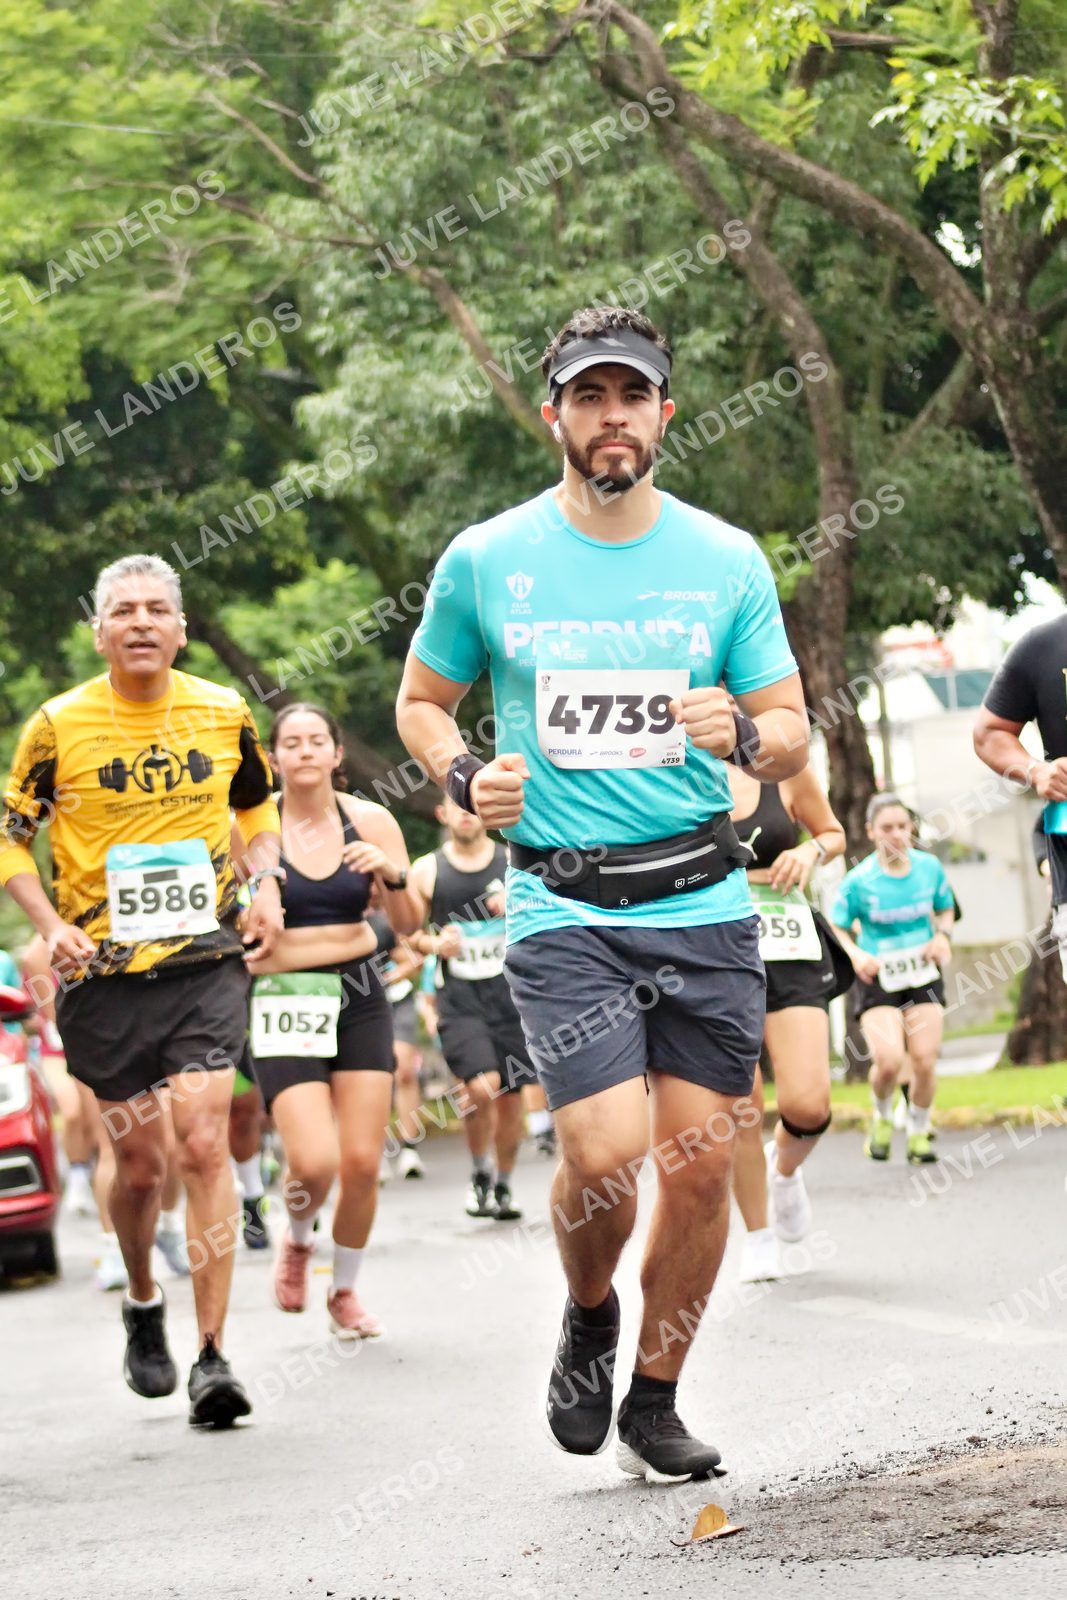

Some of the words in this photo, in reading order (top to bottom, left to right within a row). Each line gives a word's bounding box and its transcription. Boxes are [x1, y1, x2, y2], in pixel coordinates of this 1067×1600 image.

[662, 591, 718, 601] BROOKS
[548, 694, 676, 735] 4739
[548, 748, 582, 756] PERDURA
[661, 757, 680, 765] 4739
[160, 793, 213, 807] ESTHER
[118, 883, 208, 915] 5986
[262, 1011, 331, 1034] 1052
